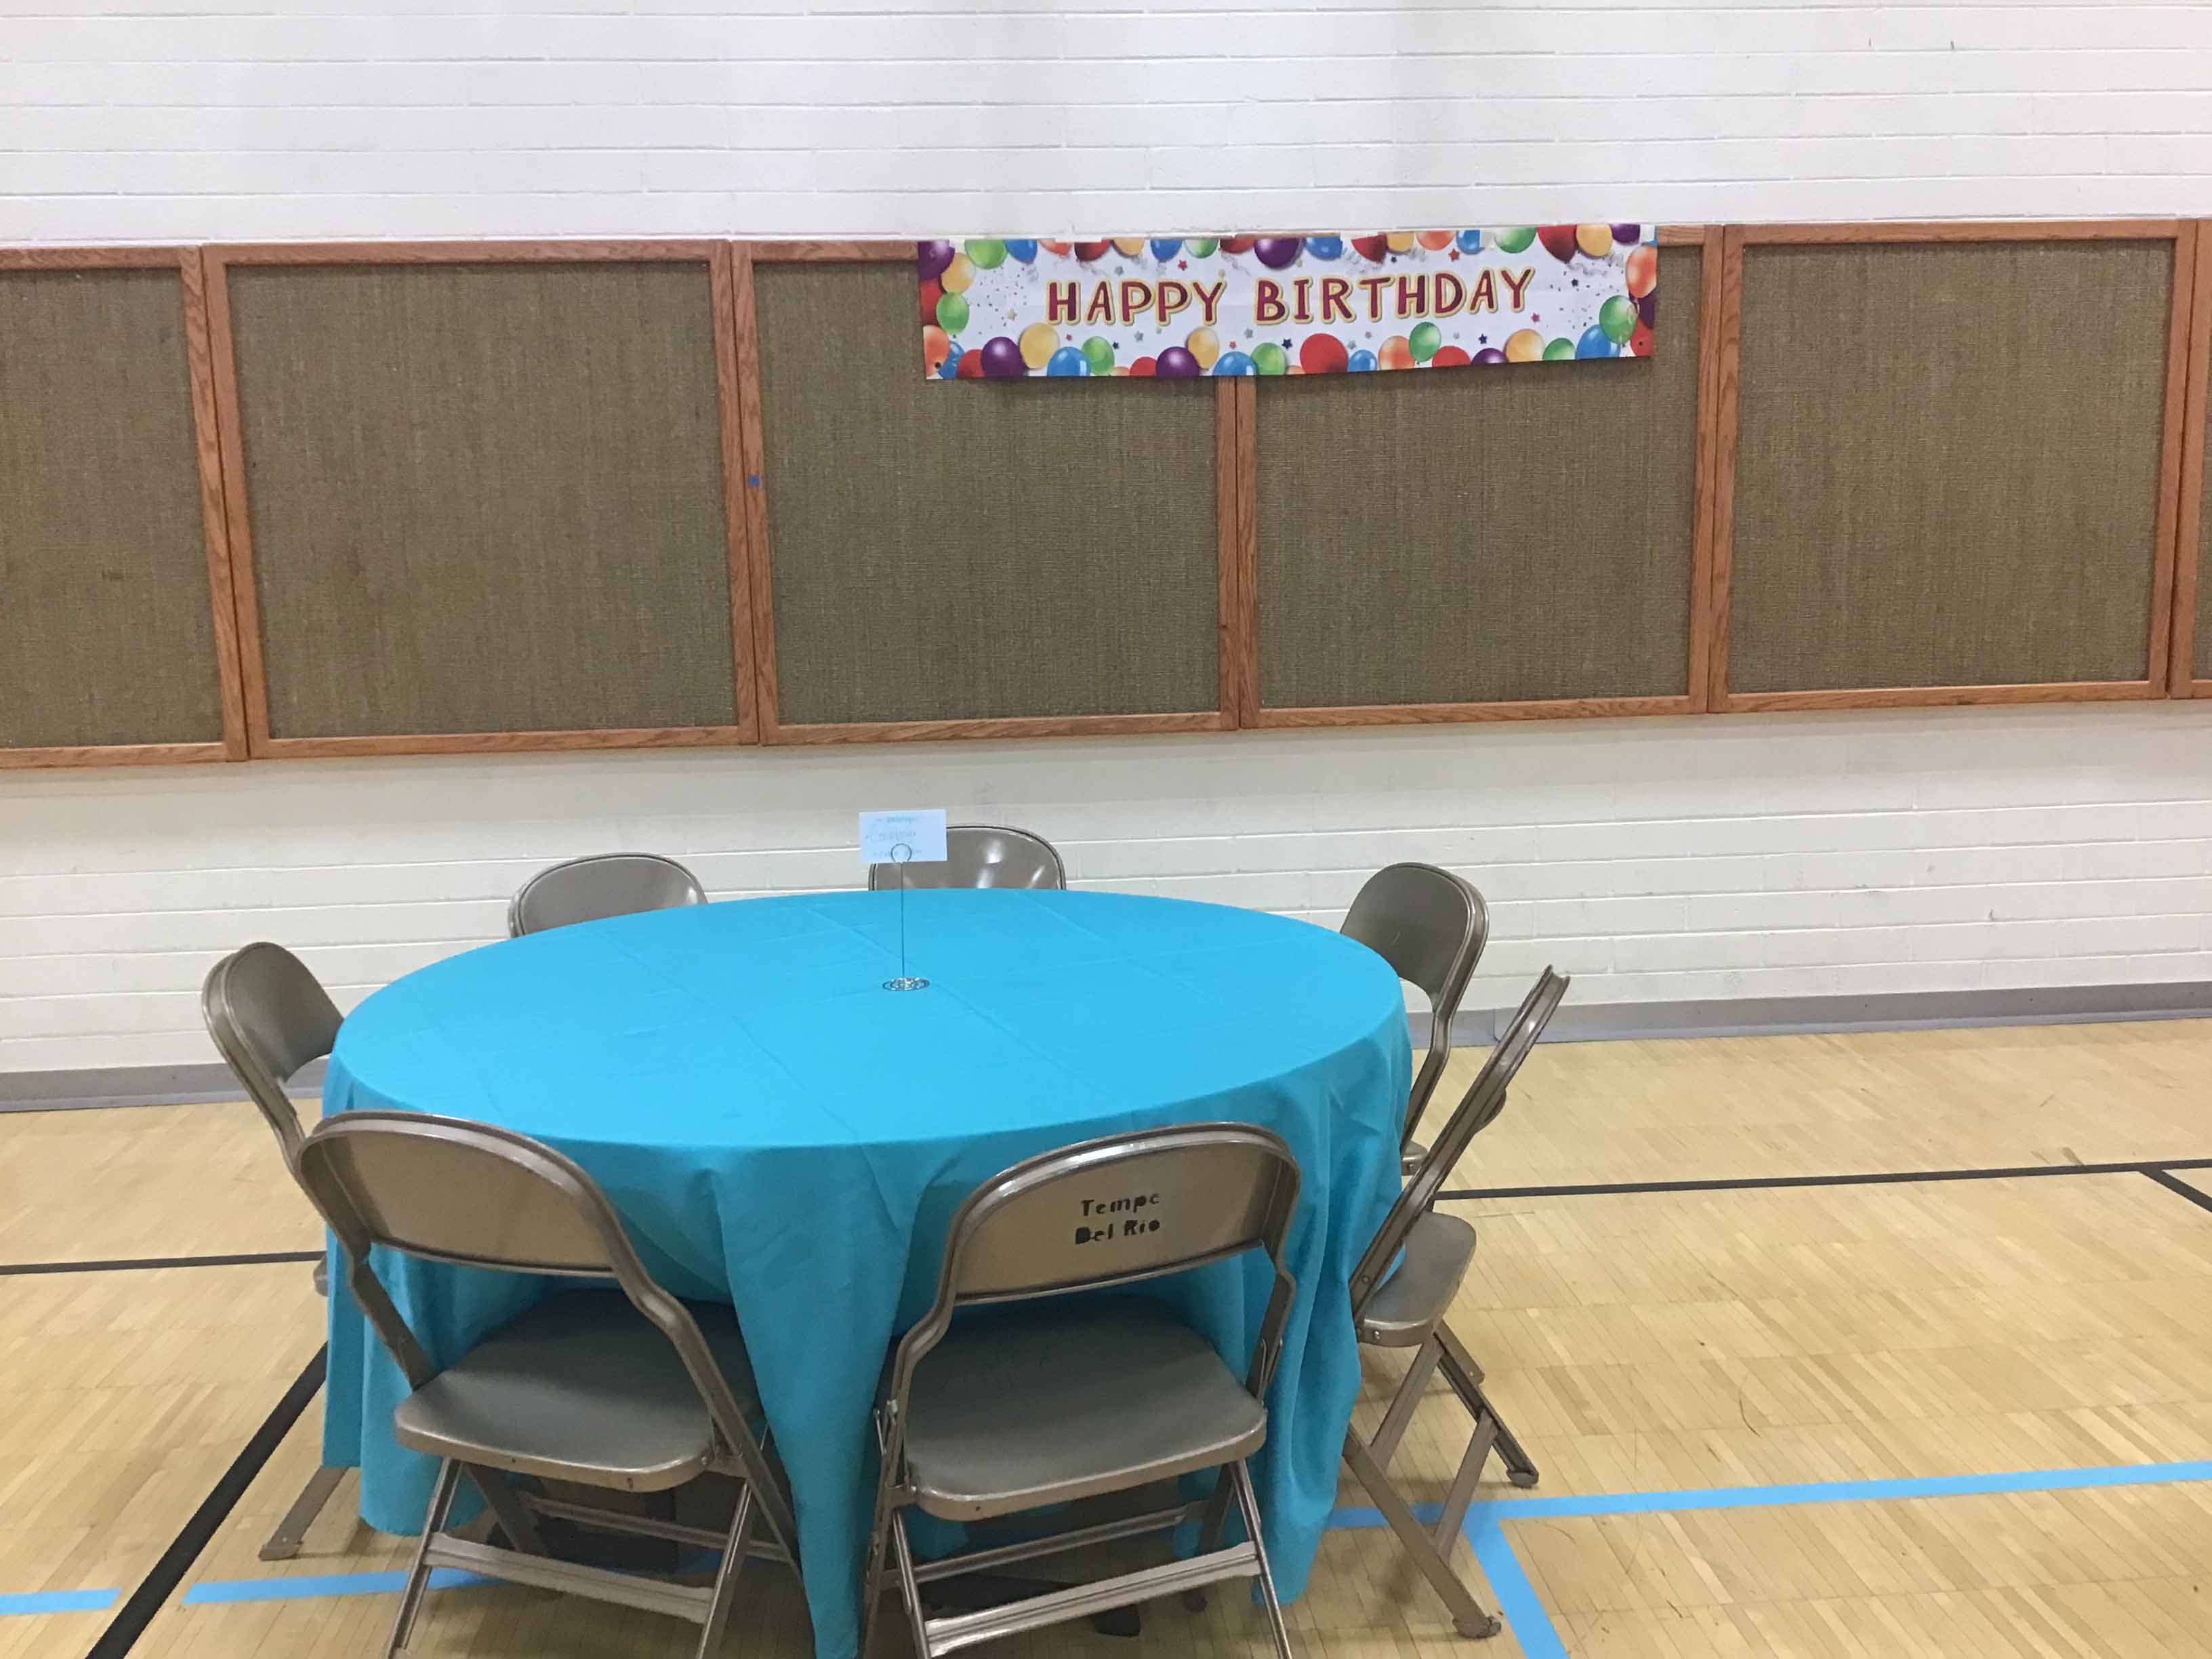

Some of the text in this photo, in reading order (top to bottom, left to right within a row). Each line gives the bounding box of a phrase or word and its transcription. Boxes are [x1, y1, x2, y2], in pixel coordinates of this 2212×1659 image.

[1046, 266, 1536, 325] HAPPY BIRTHDAY
[1075, 1219, 1161, 1245] Del Rio
